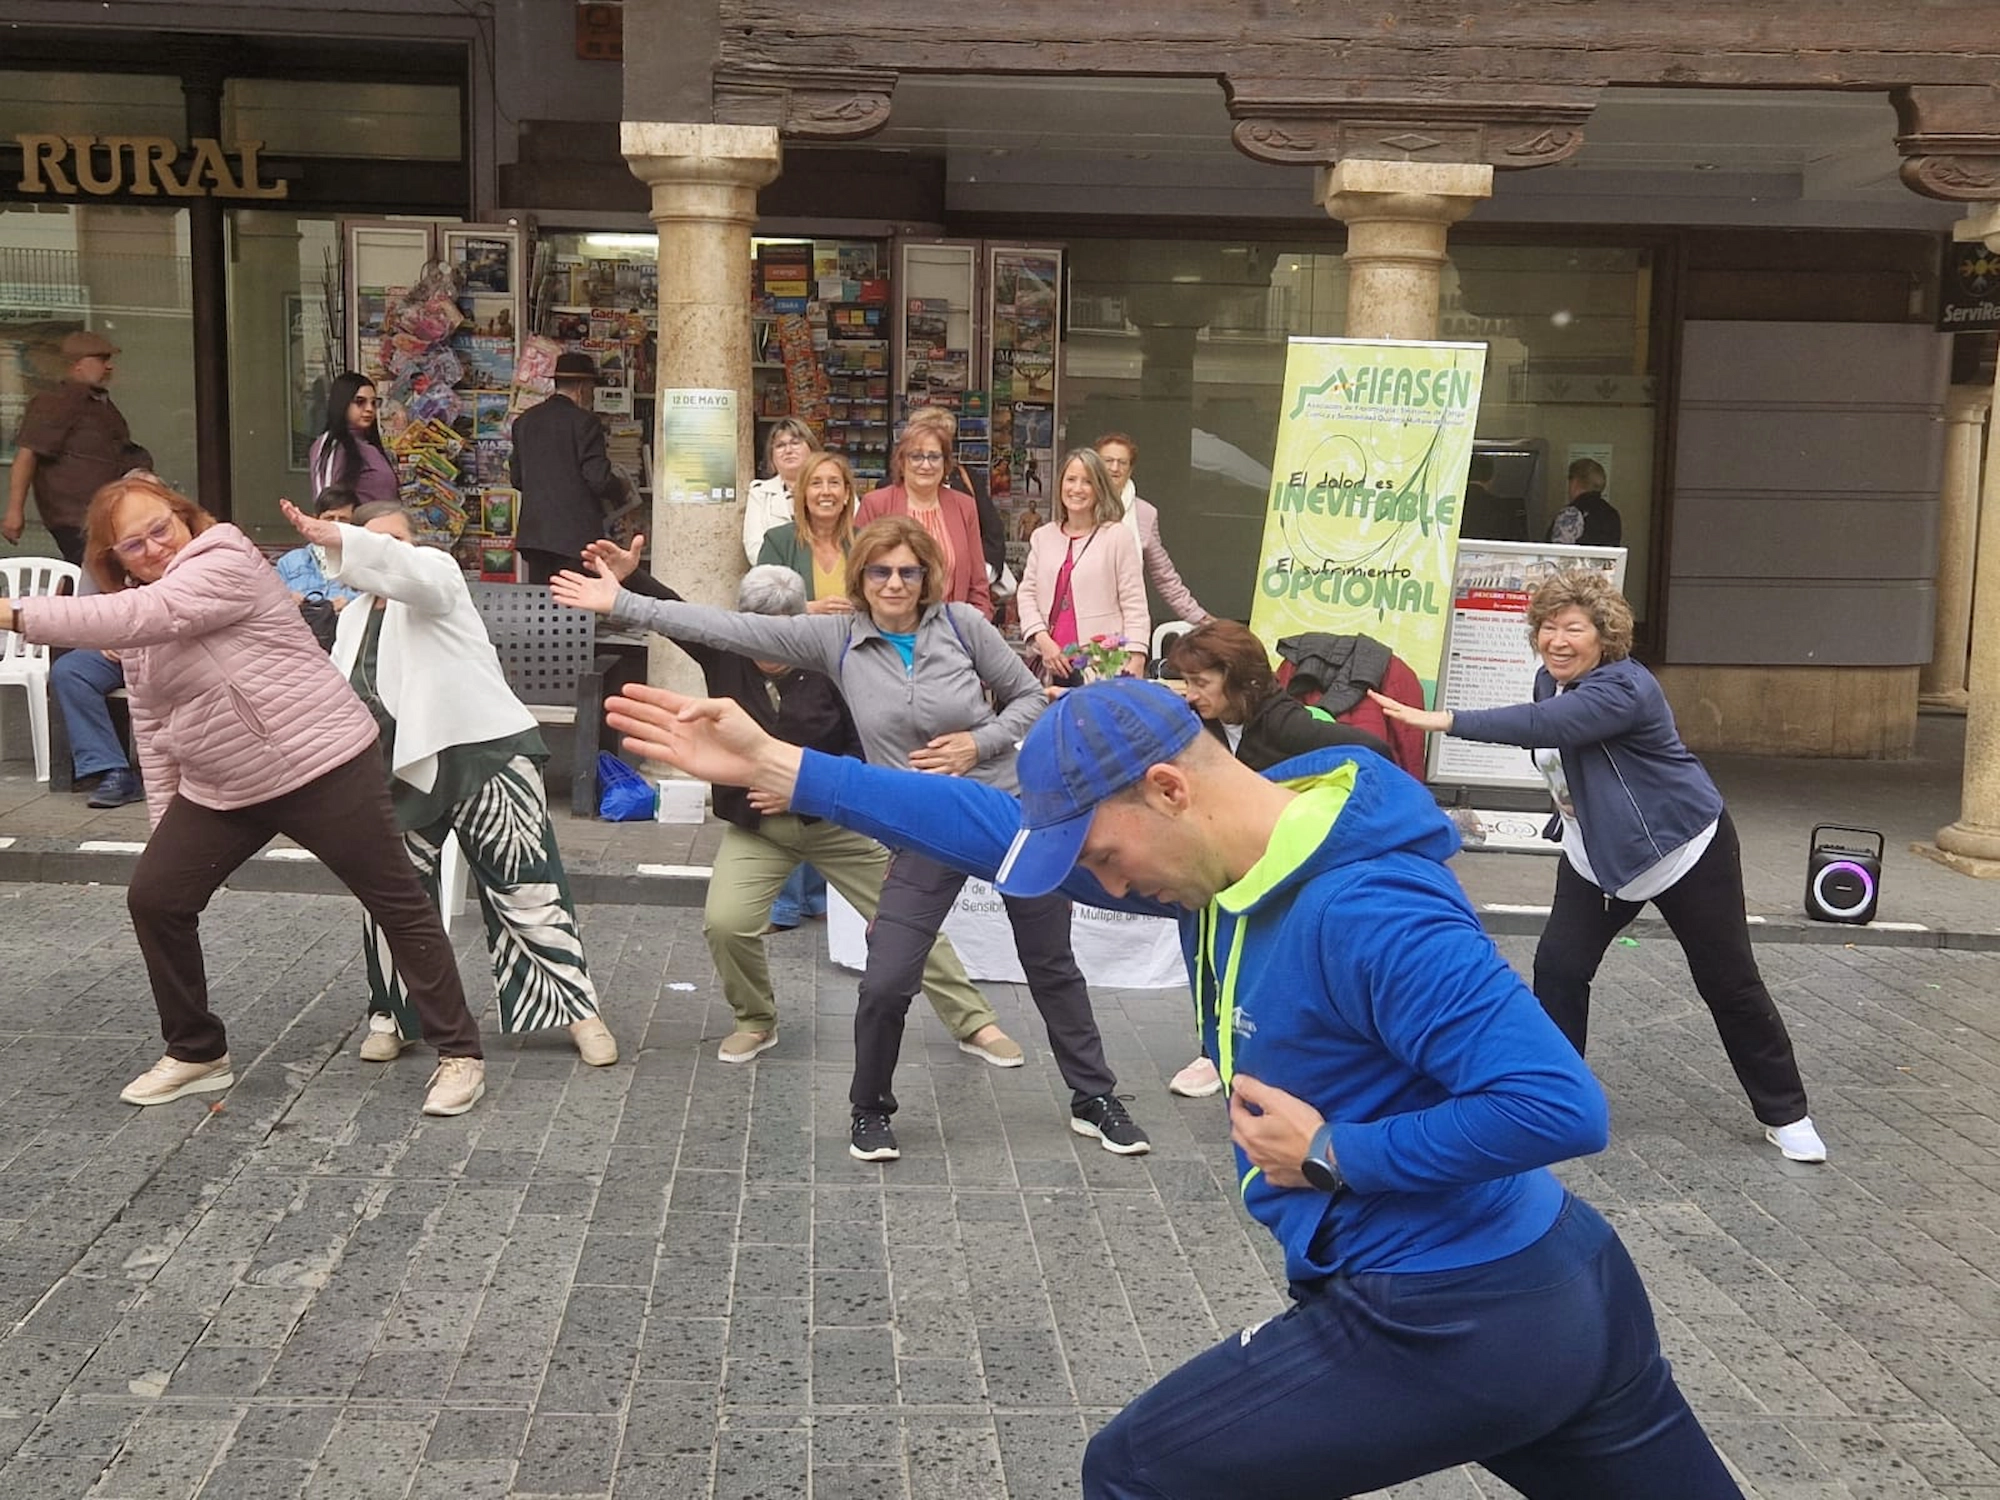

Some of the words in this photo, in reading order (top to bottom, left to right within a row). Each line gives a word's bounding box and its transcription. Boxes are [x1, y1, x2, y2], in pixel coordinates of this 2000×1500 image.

[16, 134, 287, 198] RURAL
[672, 396, 681, 405] 12
[683, 396, 697, 405] DE
[698, 396, 729, 406] MAYO
[1289, 471, 1308, 488] El
[1375, 479, 1393, 490] es
[1273, 480, 1457, 526] INEVITABLE
[1276, 557, 1295, 575] El
[1303, 558, 1411, 579] sufrimiento
[1262, 566, 1440, 615] OPCIONAL
[971, 882, 986, 895] de
